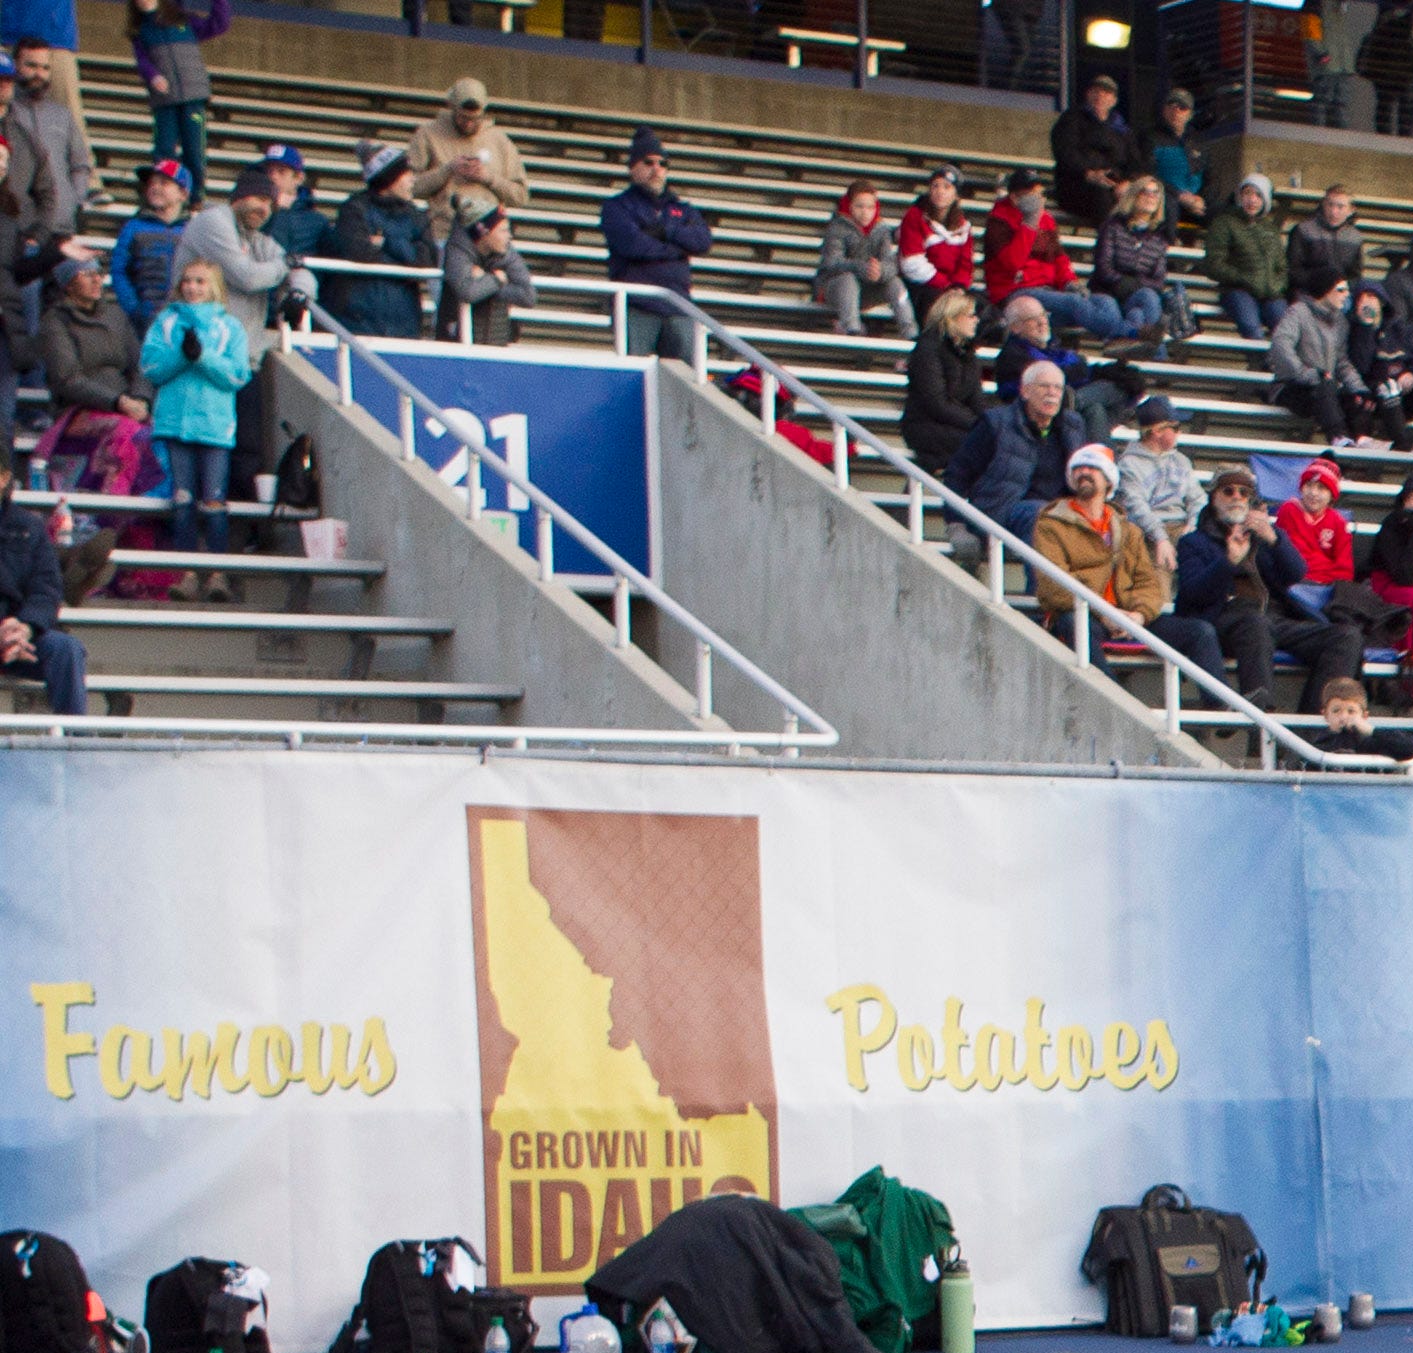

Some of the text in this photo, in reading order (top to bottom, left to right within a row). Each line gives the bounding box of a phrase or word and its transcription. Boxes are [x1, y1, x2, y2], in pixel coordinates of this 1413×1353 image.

[424, 407, 531, 512] 21
[30, 981, 1180, 1100] Famous Potatoes
[509, 1129, 704, 1170] GROWN IN
[509, 1175, 758, 1275] IDA
